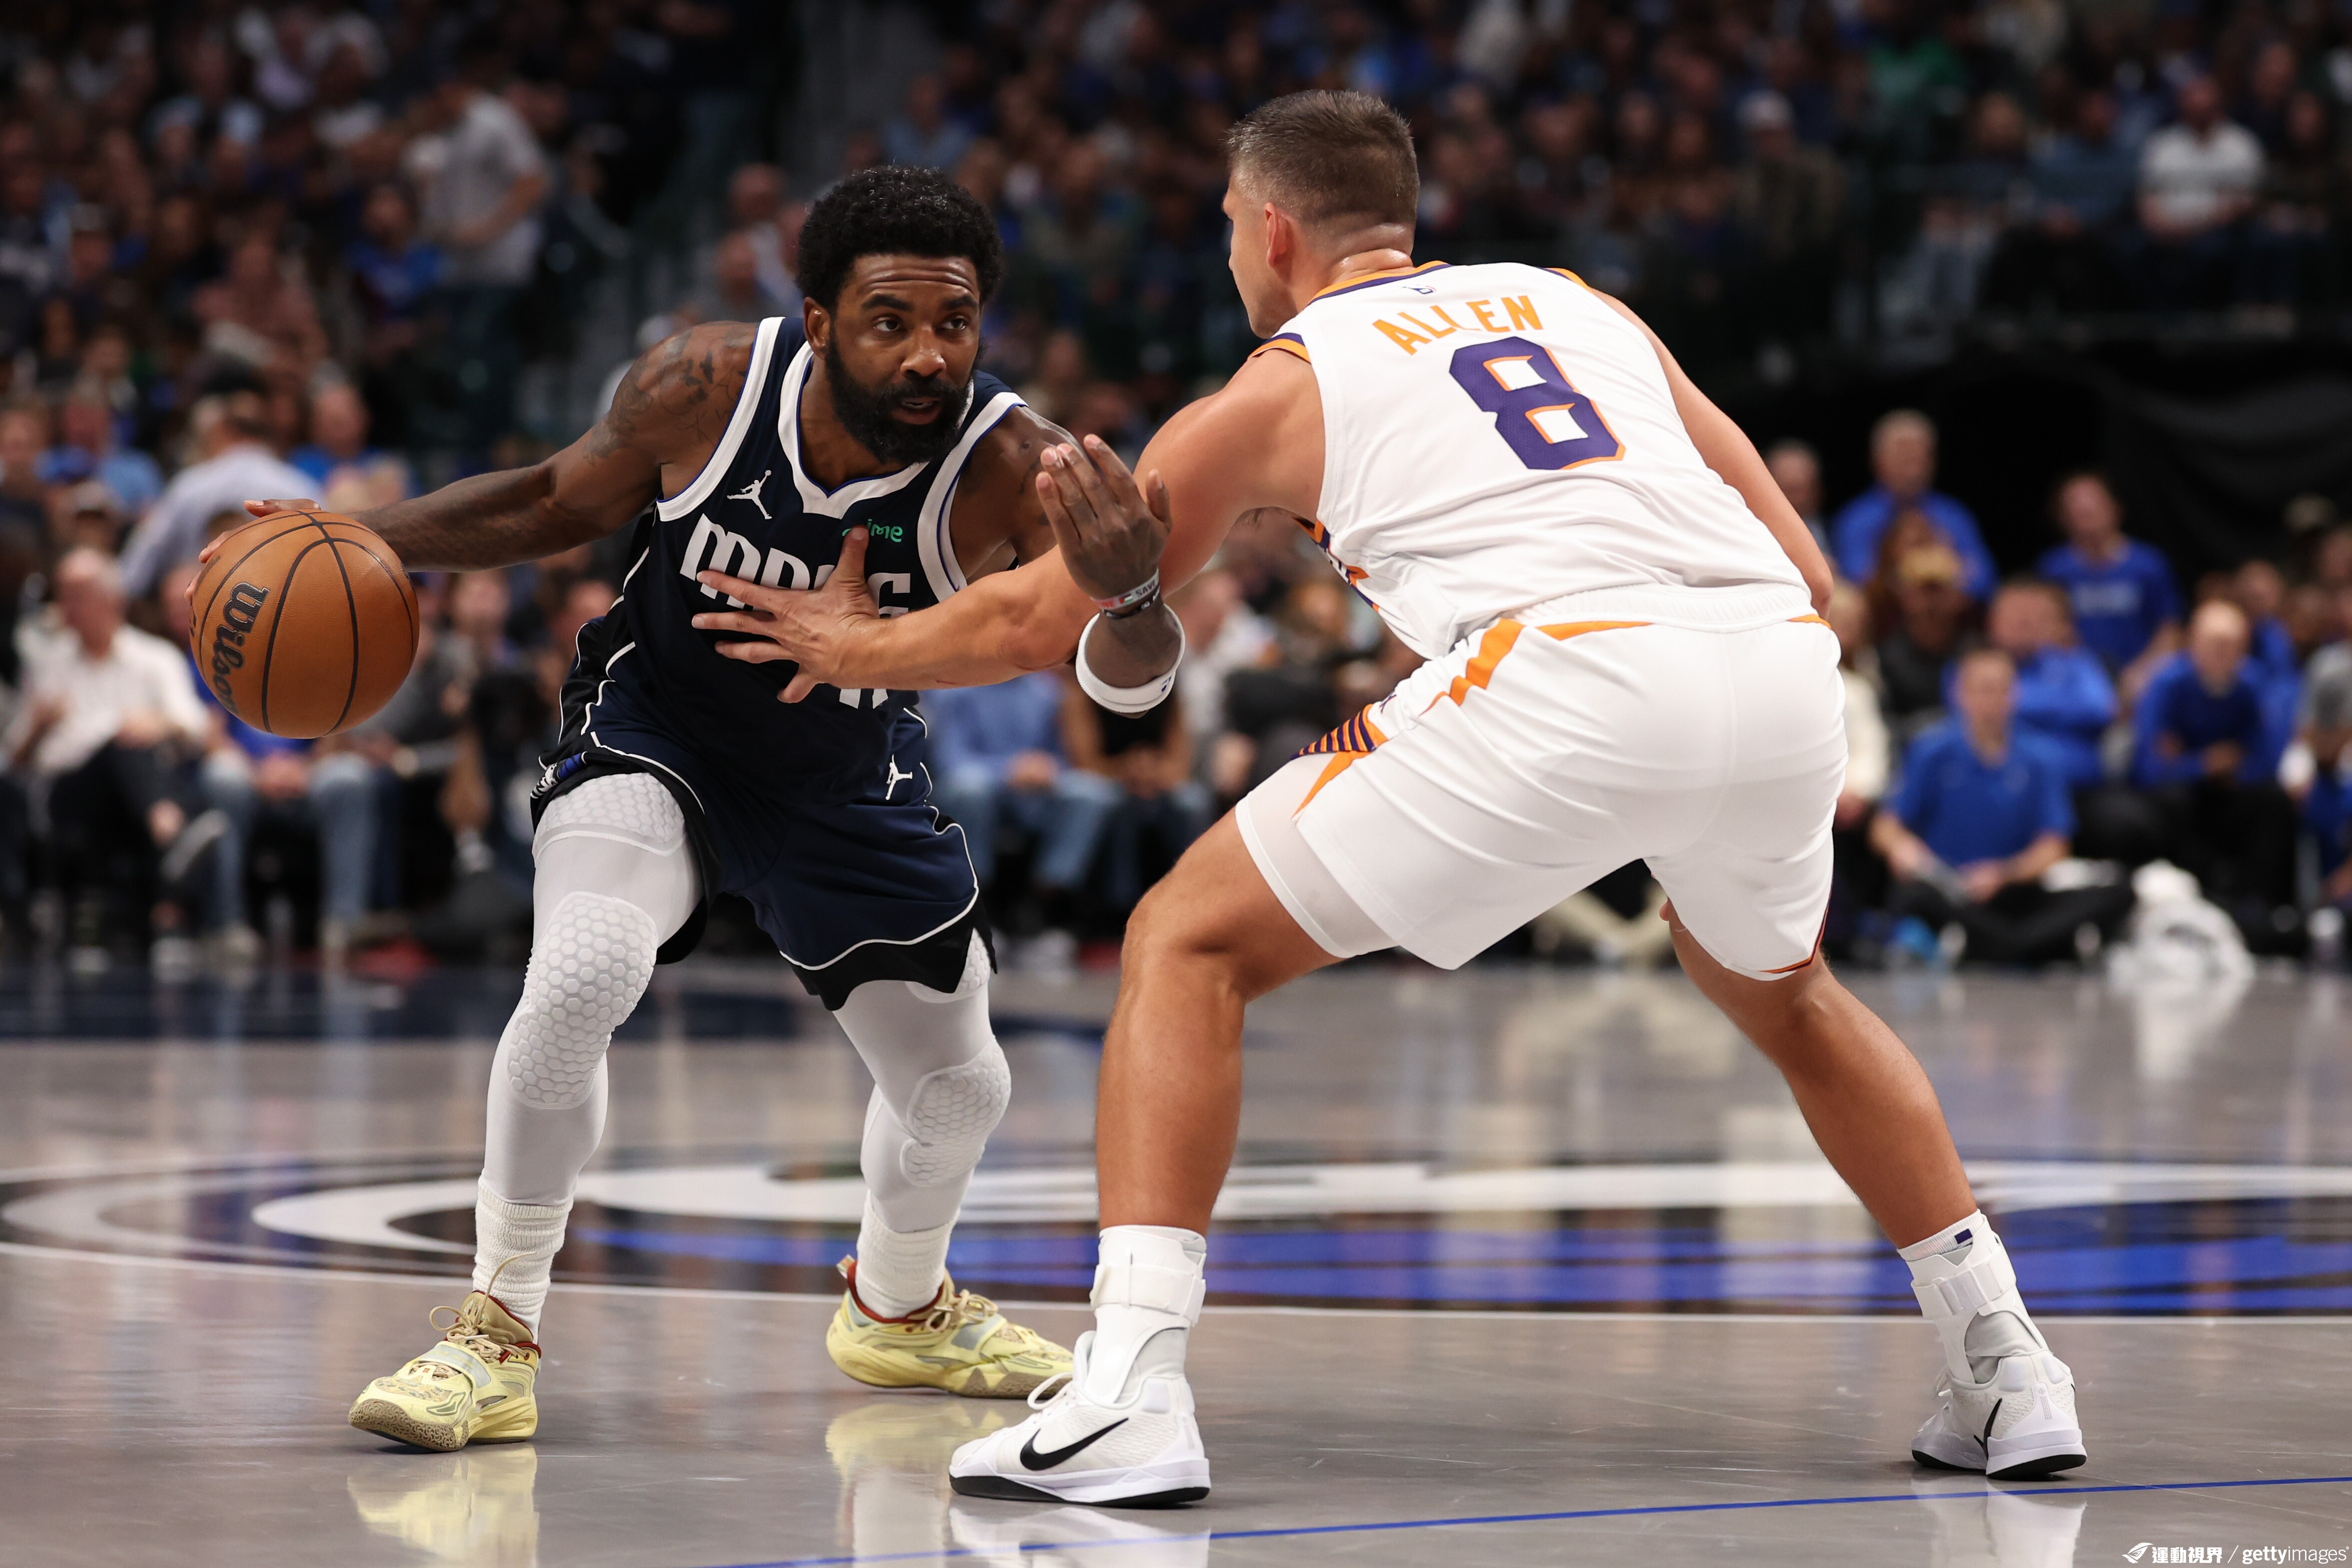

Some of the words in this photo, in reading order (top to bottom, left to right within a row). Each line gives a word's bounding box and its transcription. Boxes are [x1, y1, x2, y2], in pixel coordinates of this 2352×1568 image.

[1372, 295, 1544, 356] ALLEN
[1449, 336, 1626, 470] 8
[842, 518, 903, 543] ime
